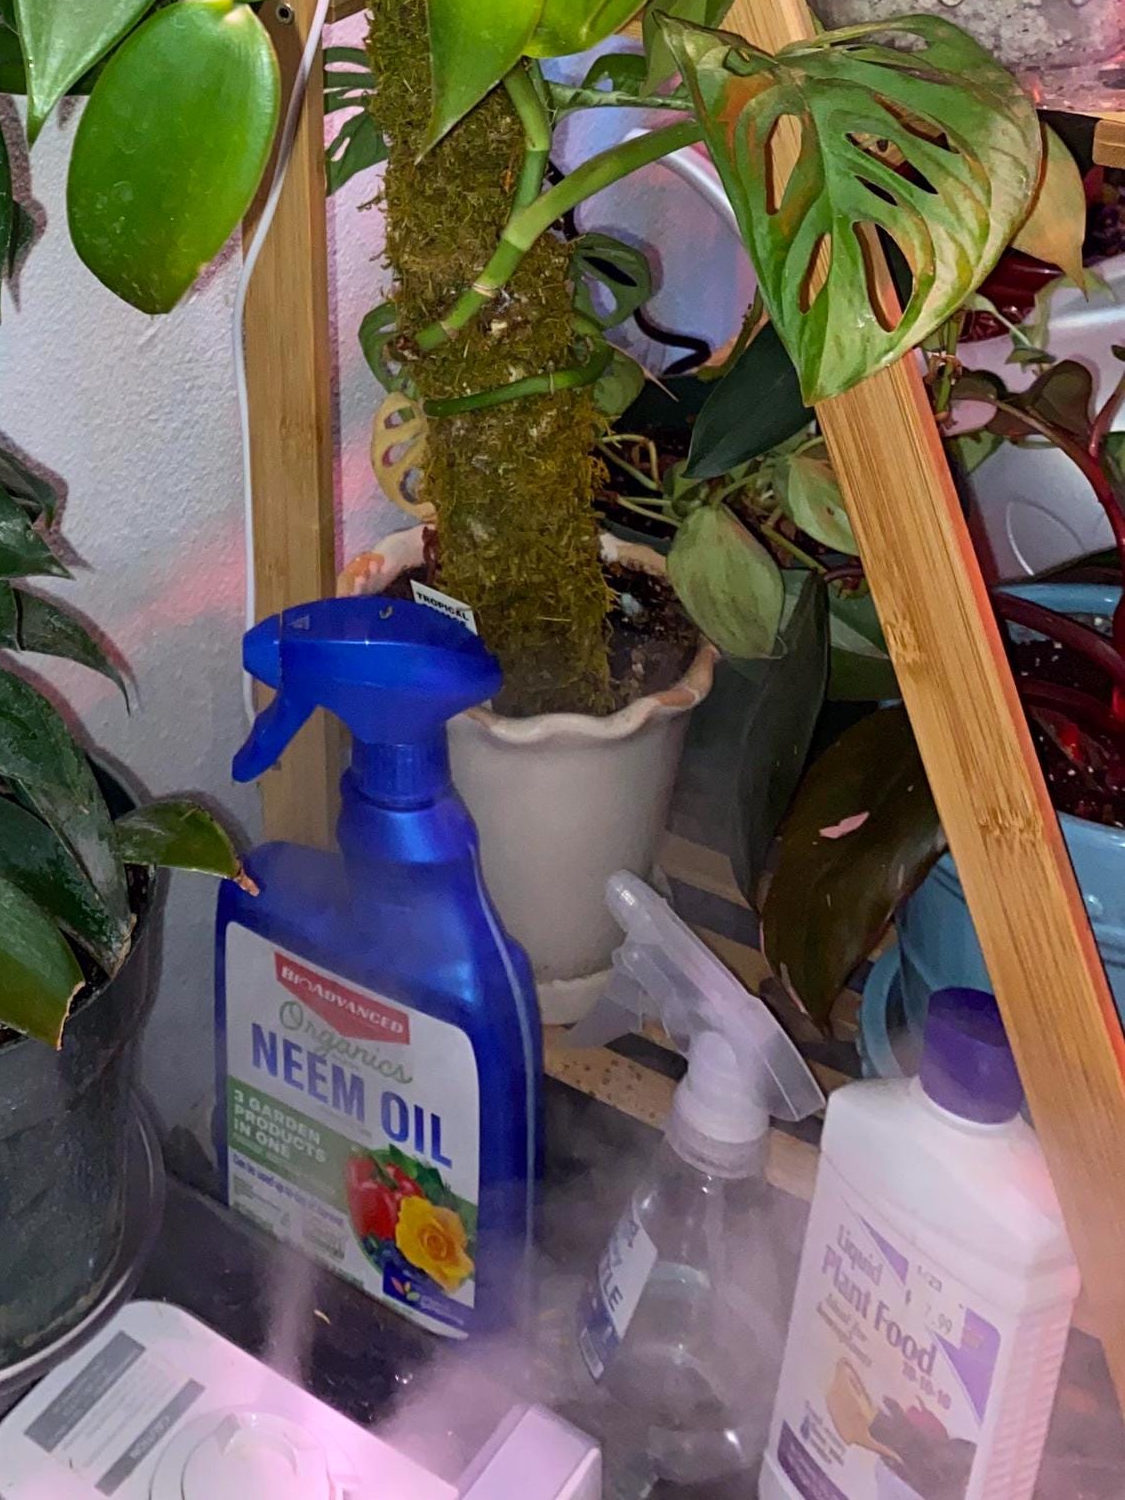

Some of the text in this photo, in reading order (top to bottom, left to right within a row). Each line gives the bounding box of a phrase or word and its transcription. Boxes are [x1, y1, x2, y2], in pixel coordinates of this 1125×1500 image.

[416, 592, 470, 621] TROPICAL
[279, 1000, 413, 1084] Organics
[234, 1088, 244, 1103] 3
[248, 1096, 321, 1145] GARDEN
[251, 1022, 365, 1124] NEEM
[380, 1091, 453, 1169] OIL
[234, 1103, 326, 1163] PRODUCTS
[234, 1117, 291, 1160] IN ONE
[837, 1223, 883, 1286] Liquid
[821, 1243, 872, 1320] Plant
[874, 1300, 936, 1378] Food
